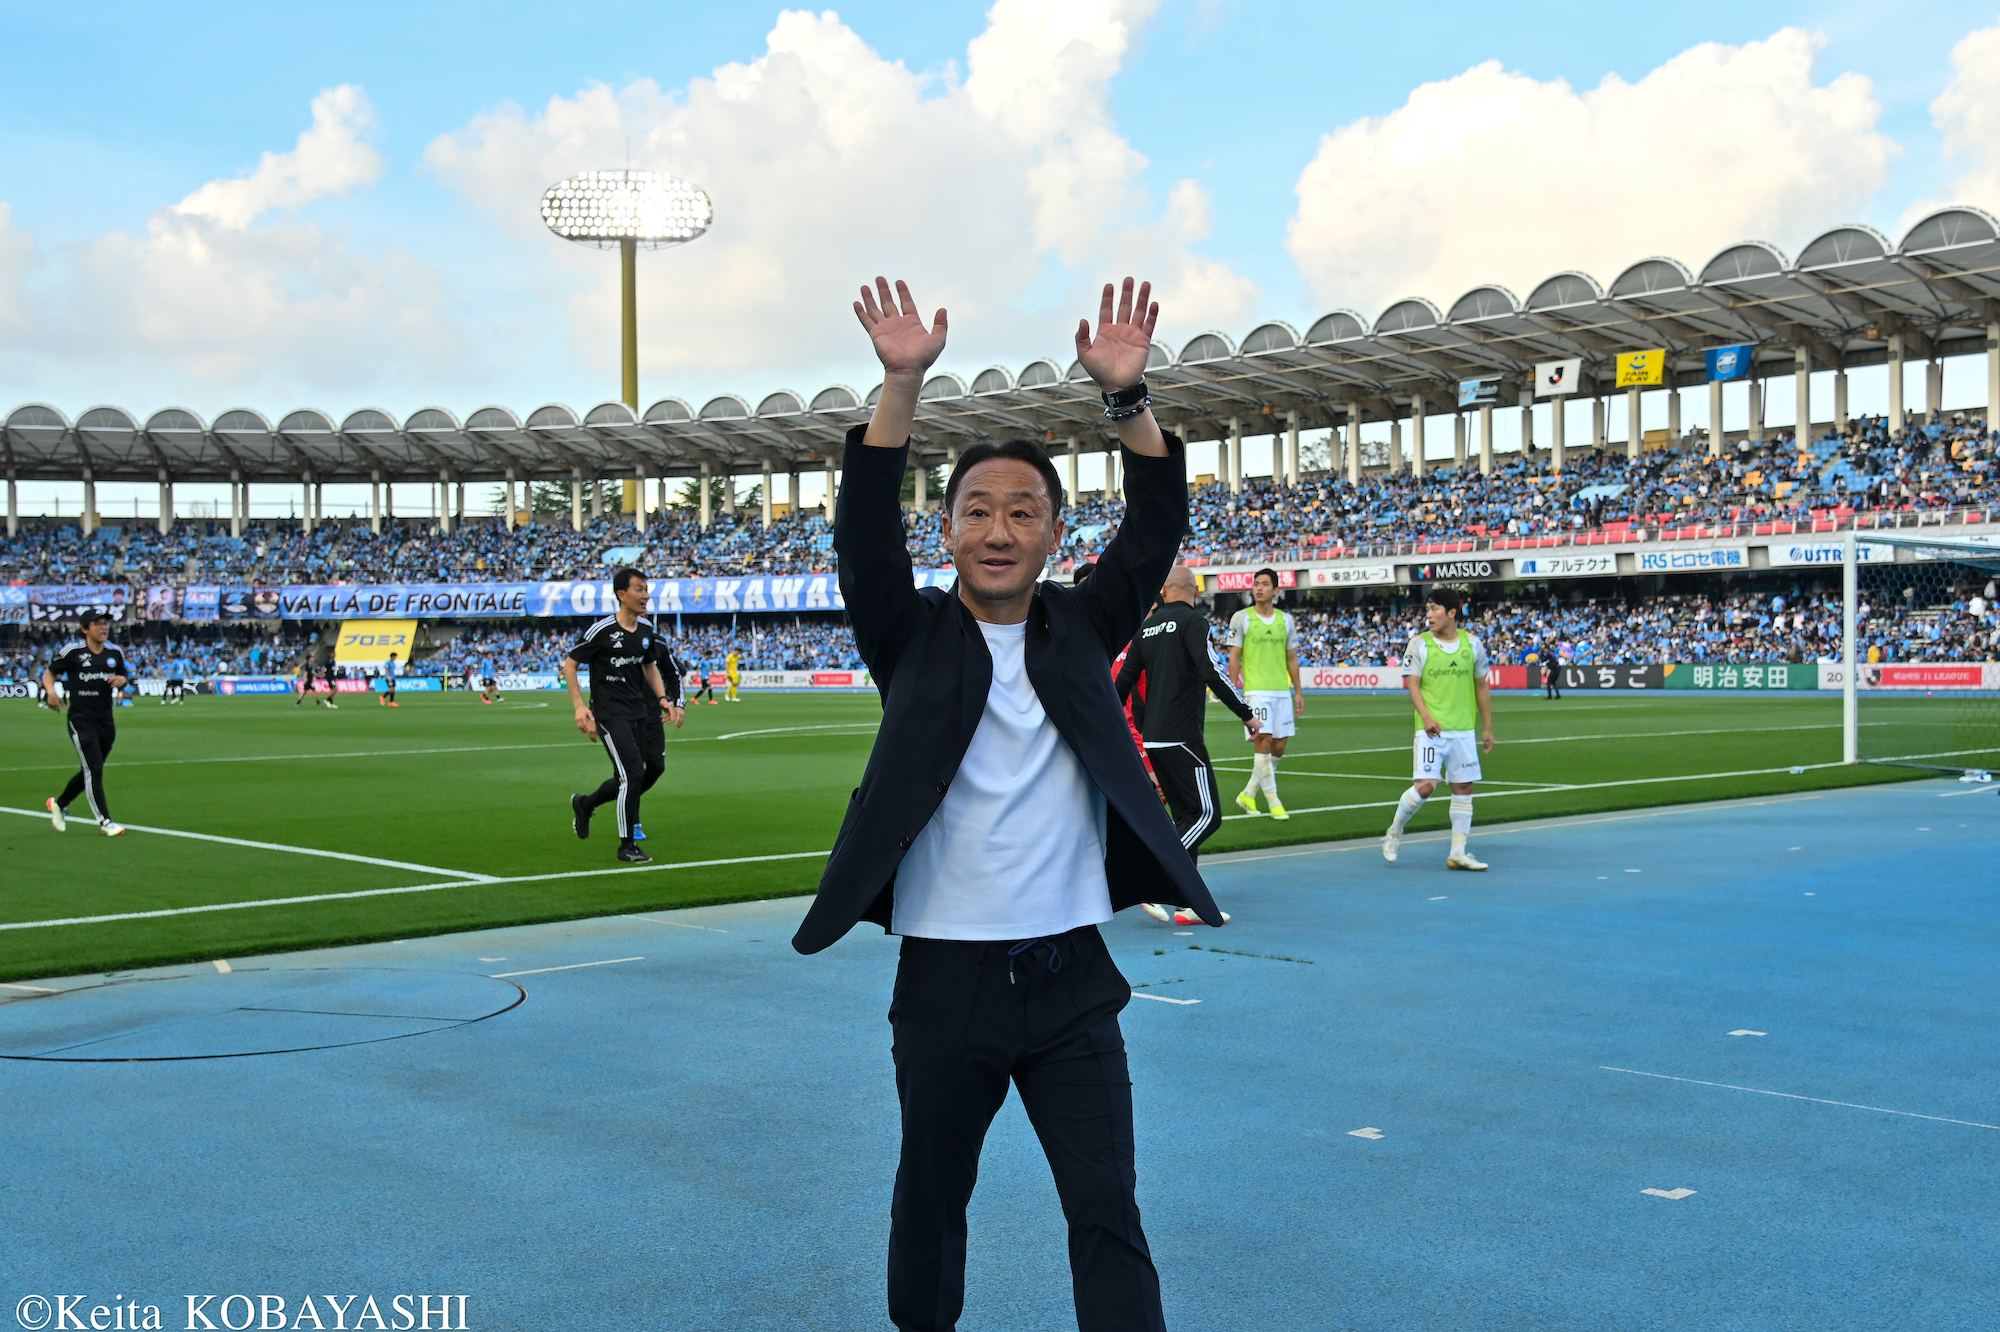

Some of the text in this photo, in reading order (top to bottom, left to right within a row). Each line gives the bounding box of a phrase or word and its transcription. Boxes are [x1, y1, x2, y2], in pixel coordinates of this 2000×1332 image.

[1549, 558, 1611, 572] アルテクナ
[1641, 550, 1741, 569] HRS ヒロセ電機
[1435, 561, 1492, 579] MATSUO
[369, 594, 399, 612] DE
[405, 592, 526, 613] FRONTALE
[343, 634, 406, 646] プロミス
[1313, 670, 1379, 686] docomo
[1566, 667, 1648, 688] いちご
[1693, 666, 1789, 688] 明治安田
[1934, 672, 1969, 680] LEAGUE
[1254, 707, 1268, 721] 90
[1423, 747, 1435, 763] 10
